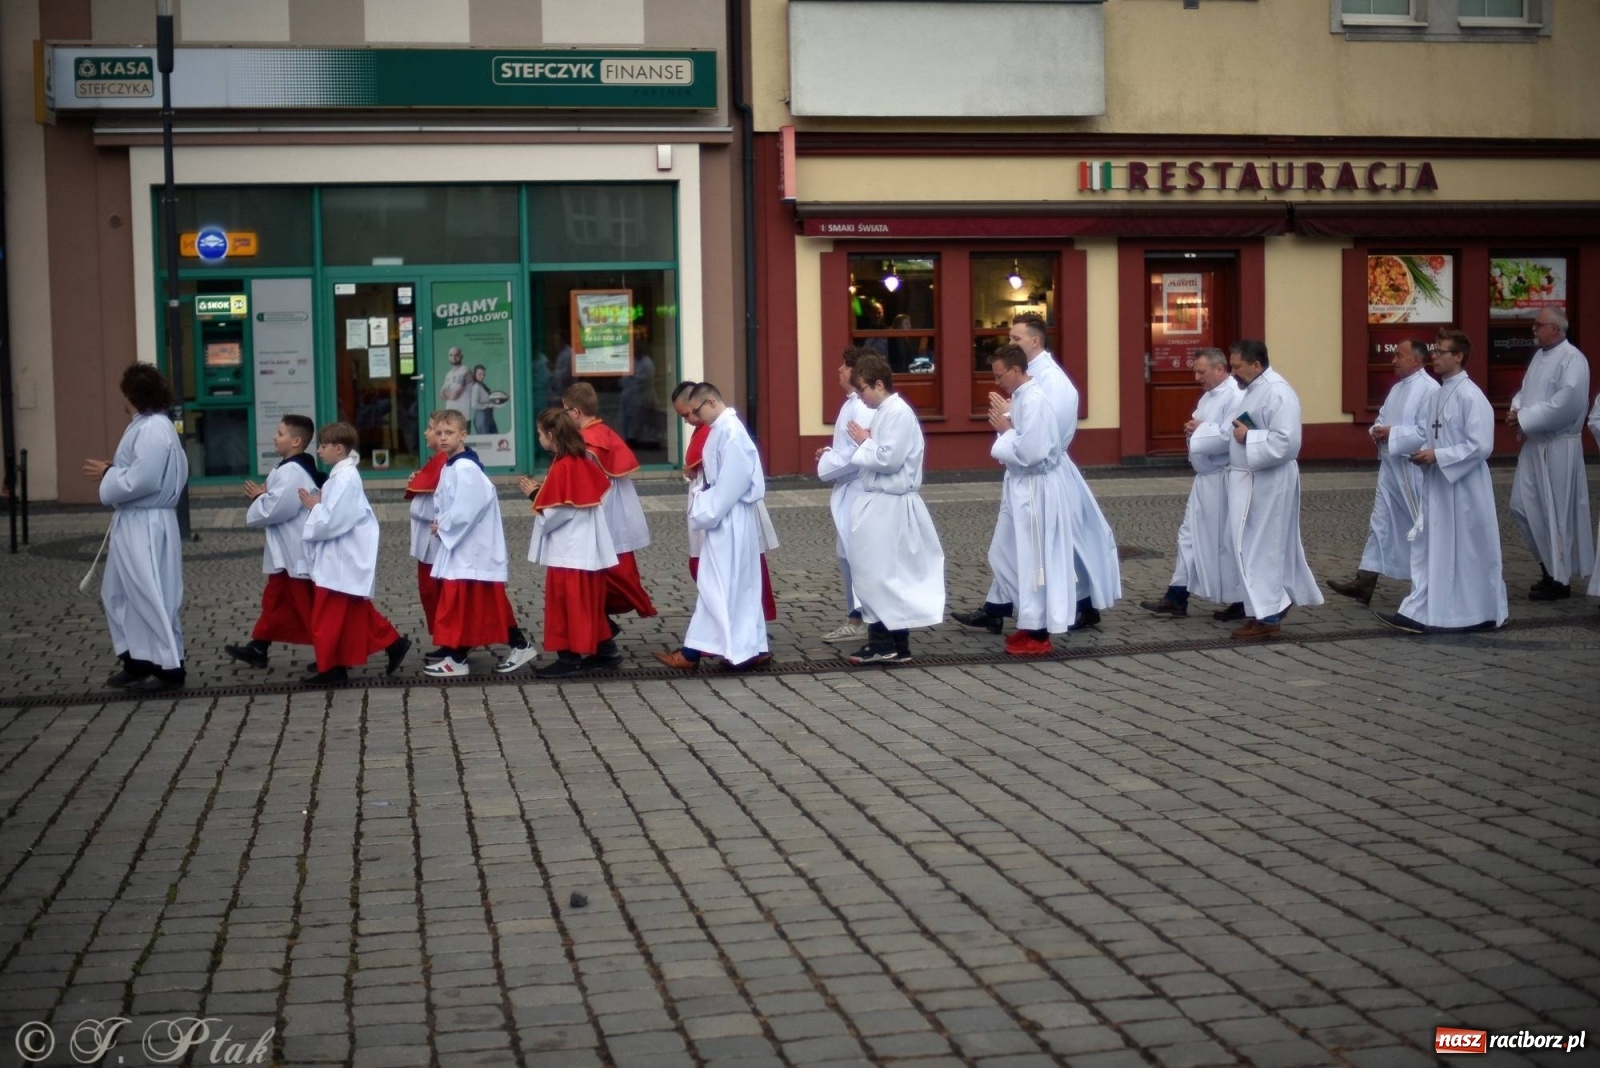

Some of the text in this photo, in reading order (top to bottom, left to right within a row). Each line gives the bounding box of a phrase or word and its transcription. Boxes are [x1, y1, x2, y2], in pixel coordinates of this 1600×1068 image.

[101, 61, 148, 75] KASA
[501, 62, 685, 80] STEFCZYK FINANSE
[80, 83, 150, 94] STEFCZYKA
[1127, 161, 1438, 192] RESTAURACJA
[828, 224, 855, 232] SMAKI
[858, 222, 889, 232] ŚWIATA
[207, 301, 230, 310] SKOK
[435, 297, 498, 319] GRAMY
[447, 311, 509, 327] ZESPOŁOWO
